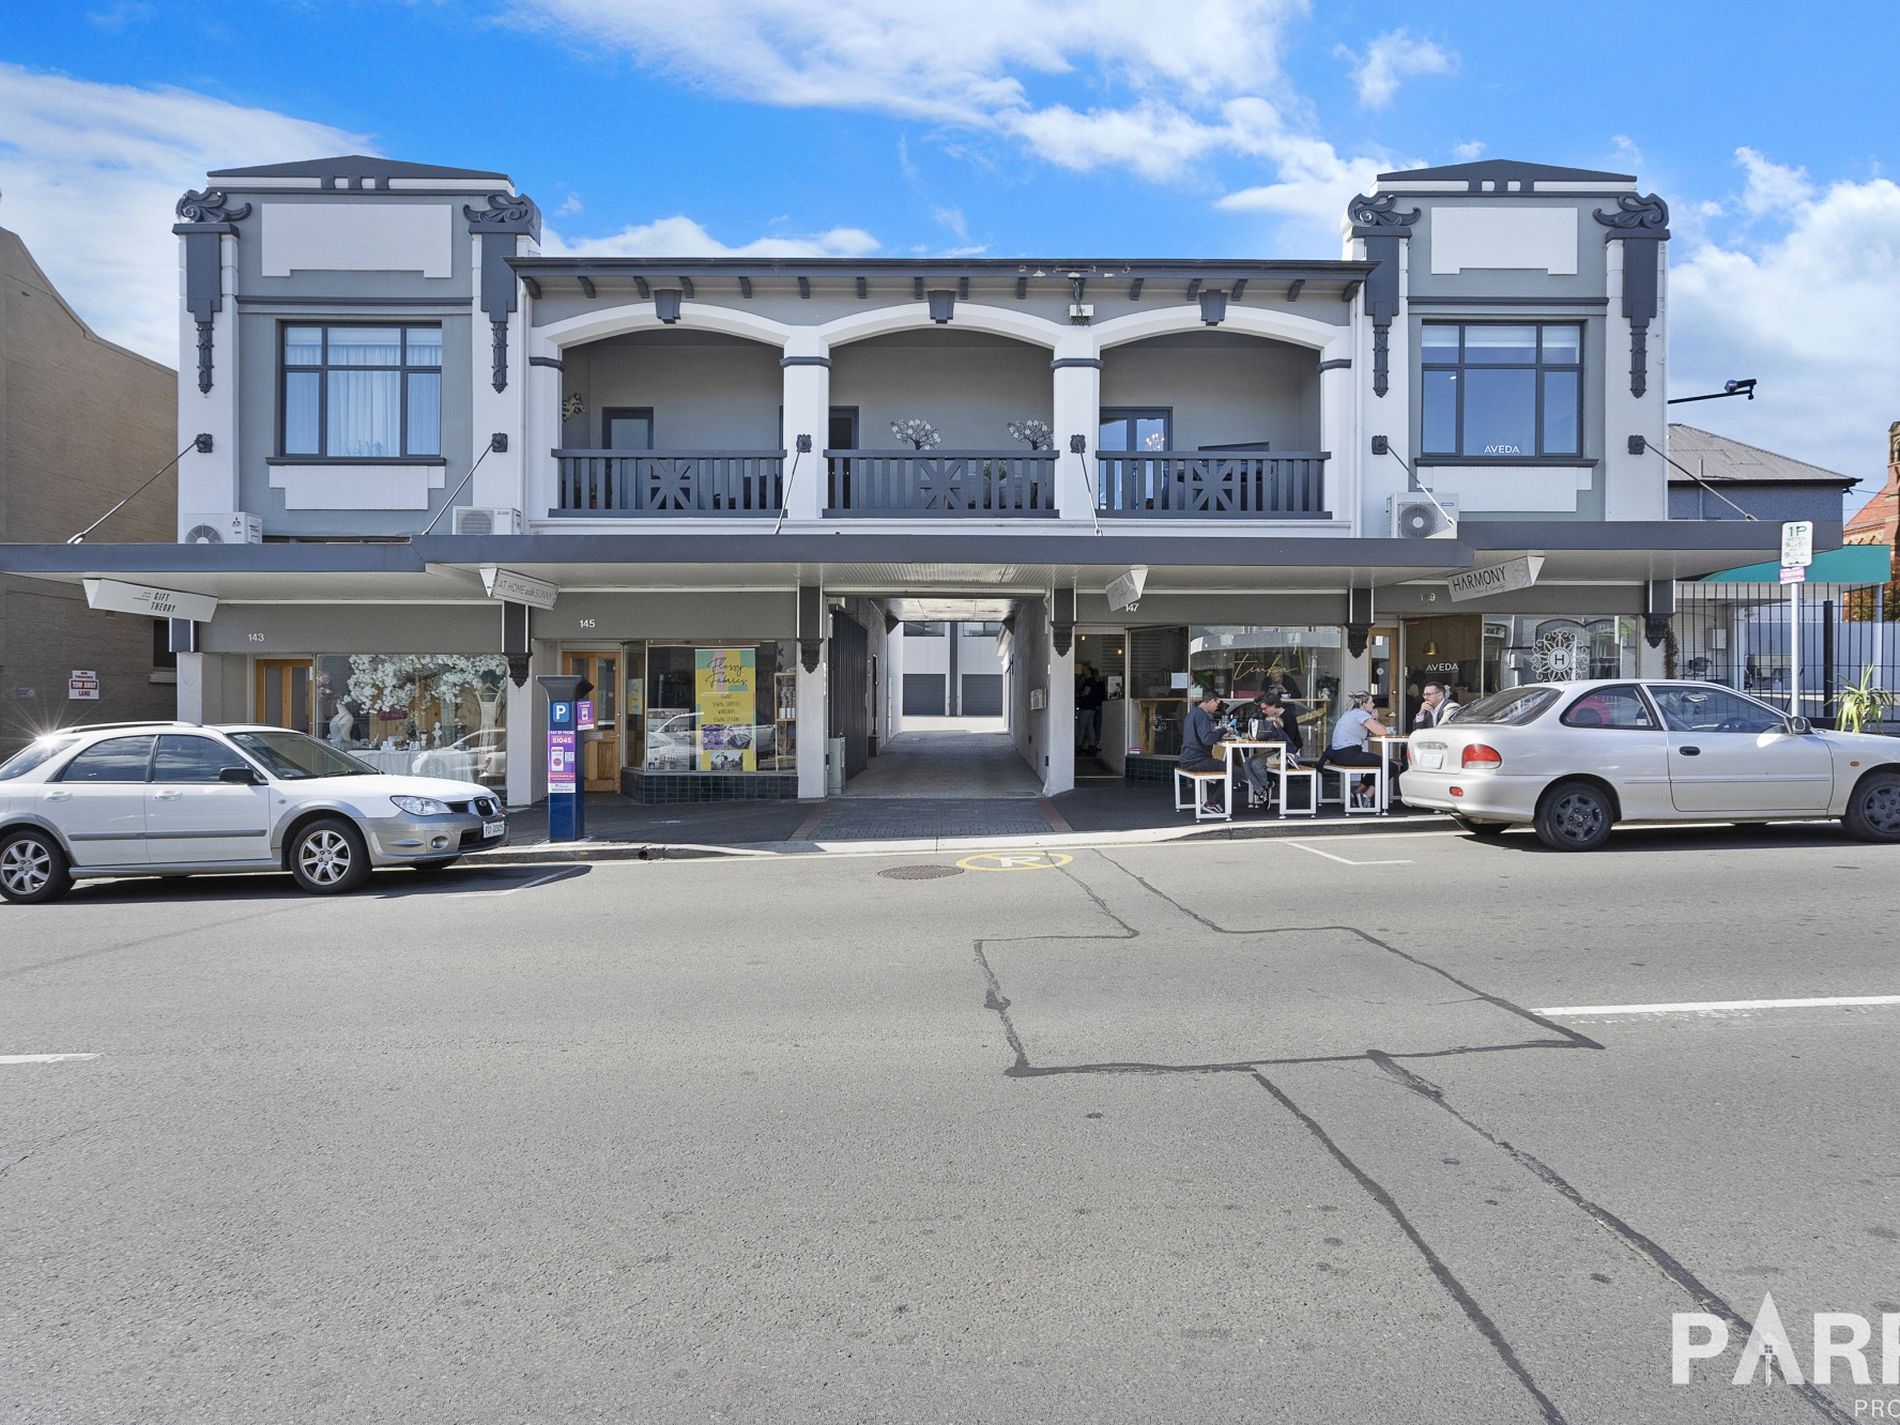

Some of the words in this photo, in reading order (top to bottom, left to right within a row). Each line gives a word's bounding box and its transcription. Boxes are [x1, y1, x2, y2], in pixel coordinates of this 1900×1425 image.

[1484, 445, 1520, 454] AVEDA
[1788, 525, 1807, 537] 1P
[1452, 566, 1506, 592] HARMONY
[153, 592, 170, 602] GIFT
[150, 602, 176, 613] THEORY
[1126, 603, 1139, 612] 147
[580, 619, 596, 628] 145
[248, 633, 264, 641] 143
[1554, 654, 1564, 665] H
[1426, 663, 1459, 671] AVEDA
[556, 705, 566, 720] P
